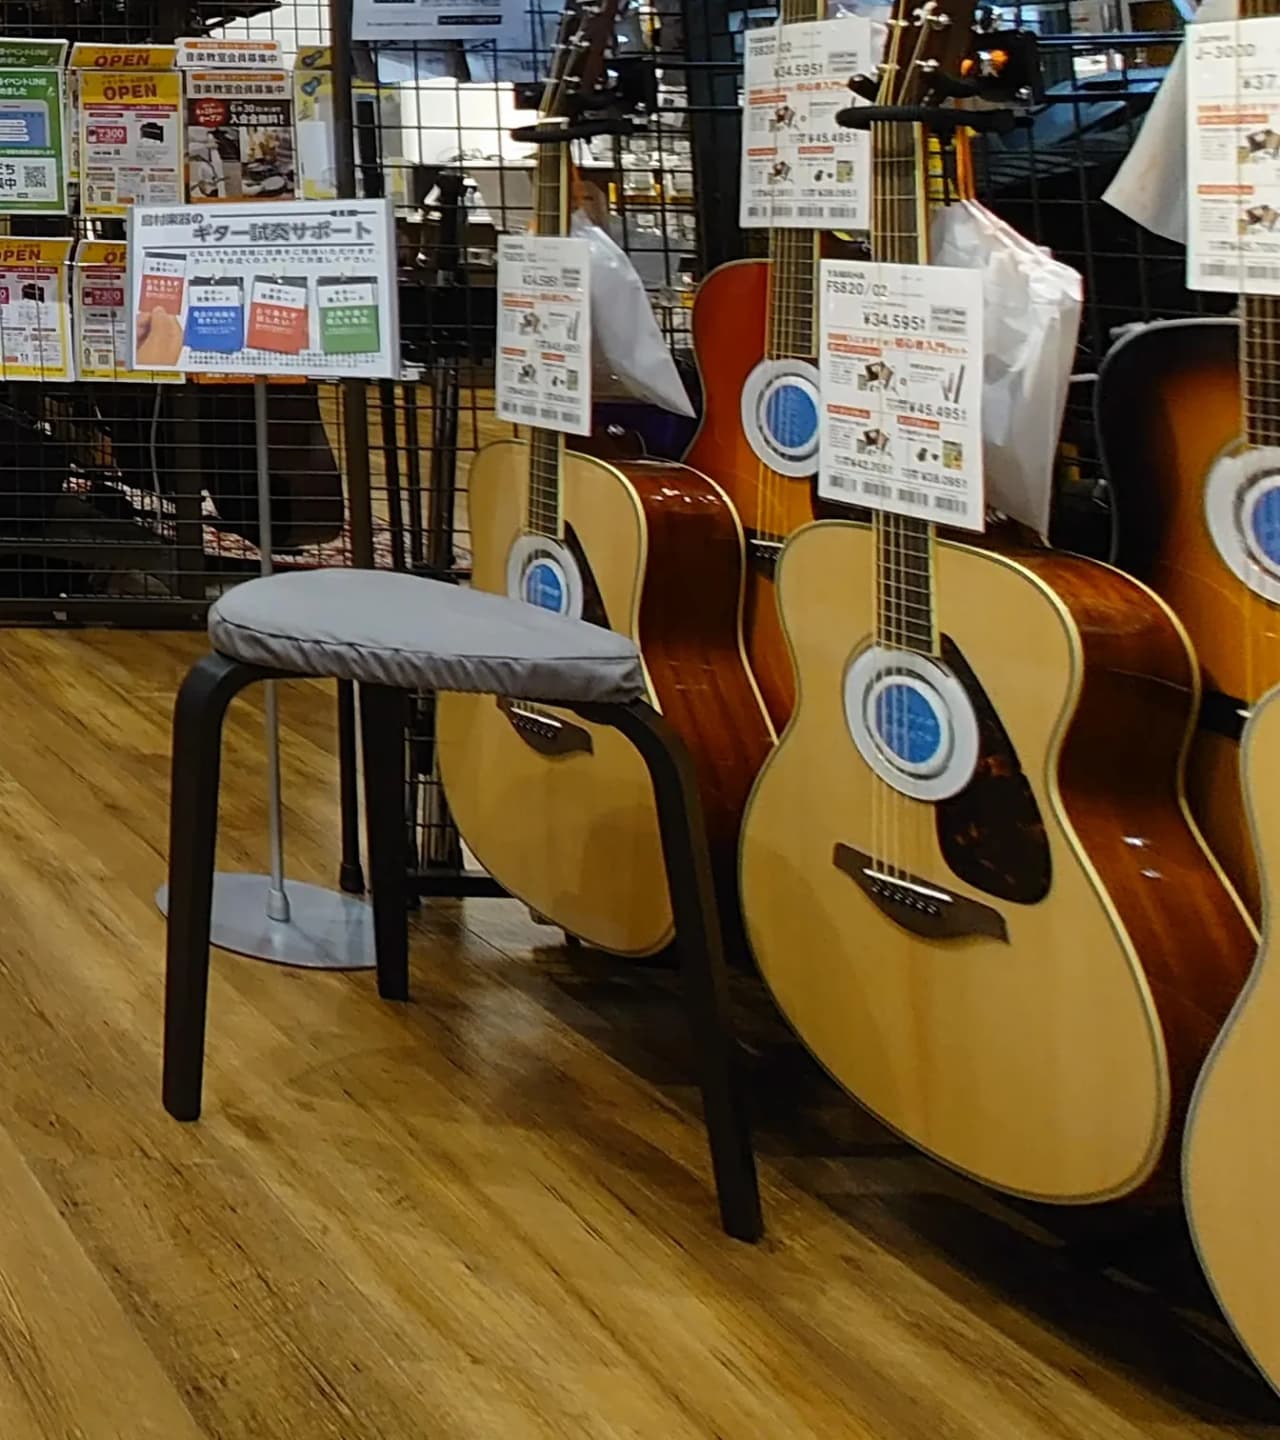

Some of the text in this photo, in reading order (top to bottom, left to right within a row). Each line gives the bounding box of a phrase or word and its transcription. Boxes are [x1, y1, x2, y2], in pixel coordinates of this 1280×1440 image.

[94, 53, 151, 68] OPEN
[185, 52, 278, 64] 音楽教室会員募集中
[103, 83, 158, 101] OPEN
[192, 84, 286, 96] 音楽教室会員募集中
[141, 212, 205, 227] 島村楽器の
[192, 221, 374, 242] ギター試奏サポート
